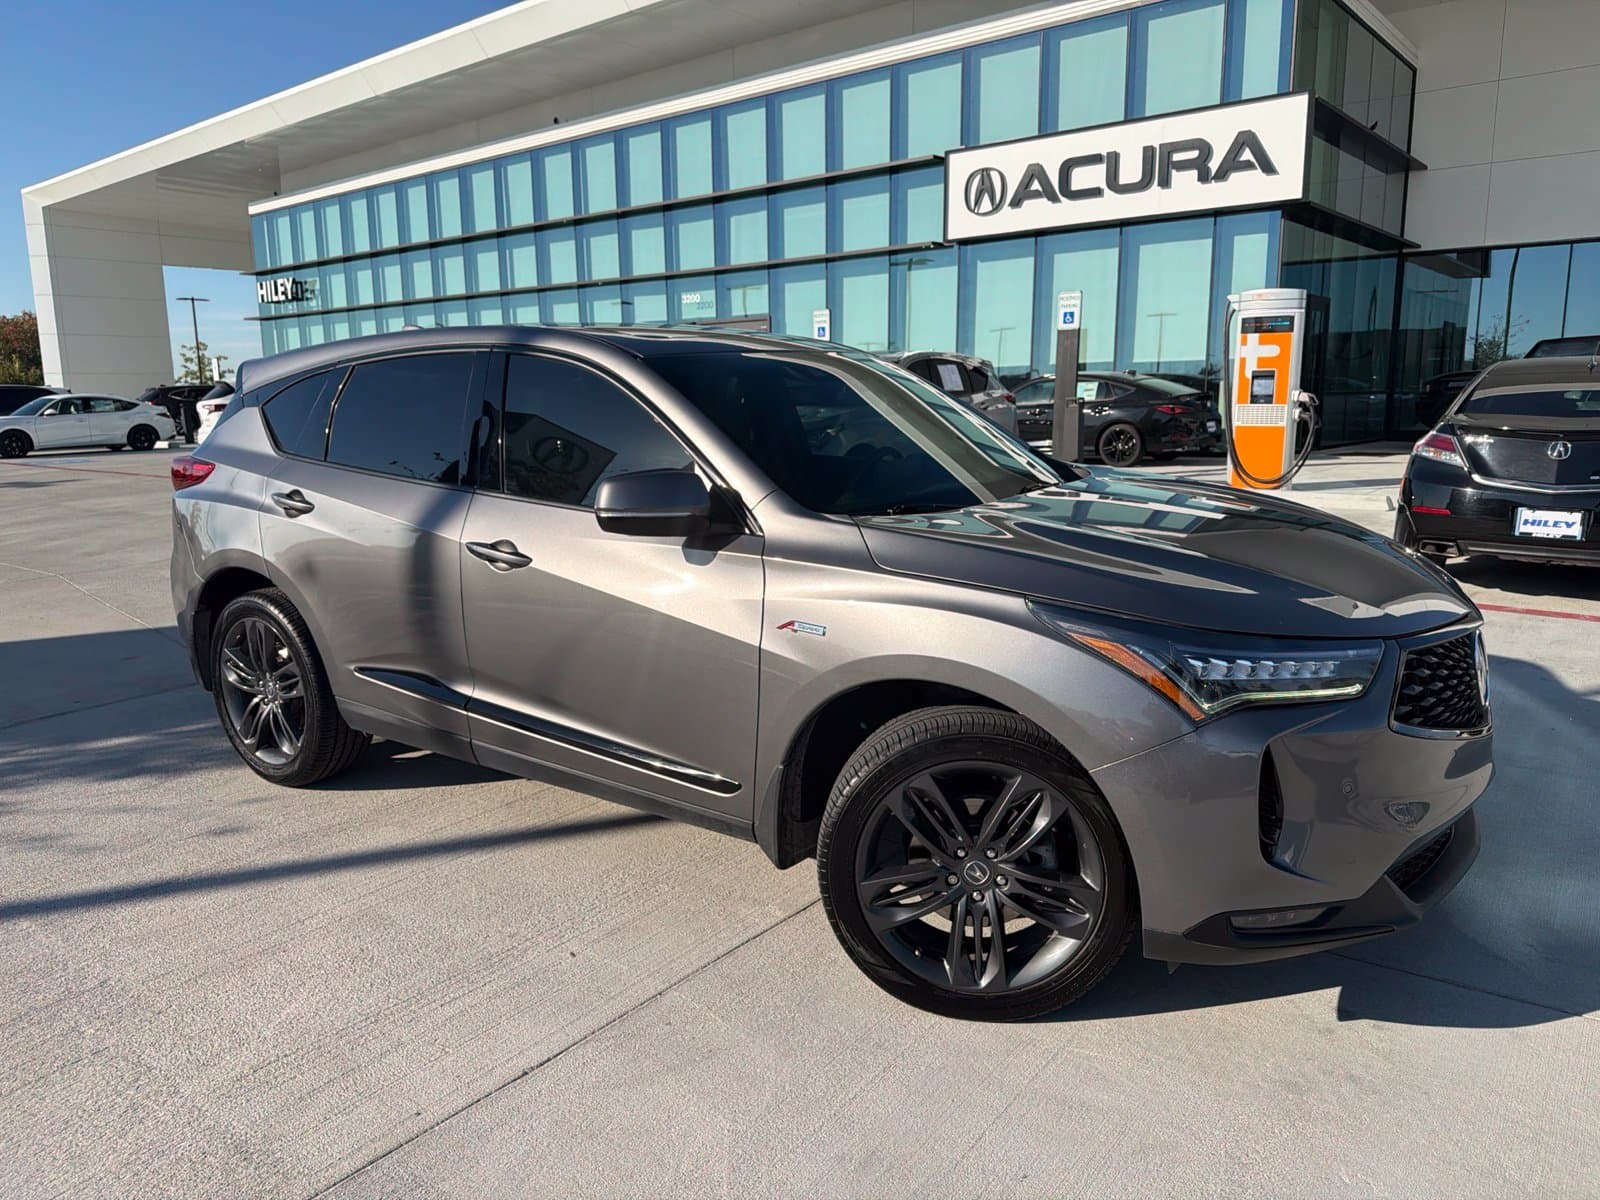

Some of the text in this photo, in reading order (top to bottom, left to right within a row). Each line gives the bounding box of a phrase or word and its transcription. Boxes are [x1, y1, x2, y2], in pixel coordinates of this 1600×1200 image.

[1008, 130, 1279, 209] ACURA
[257, 277, 292, 303] HILEY
[1522, 518, 1577, 529] HILEY
